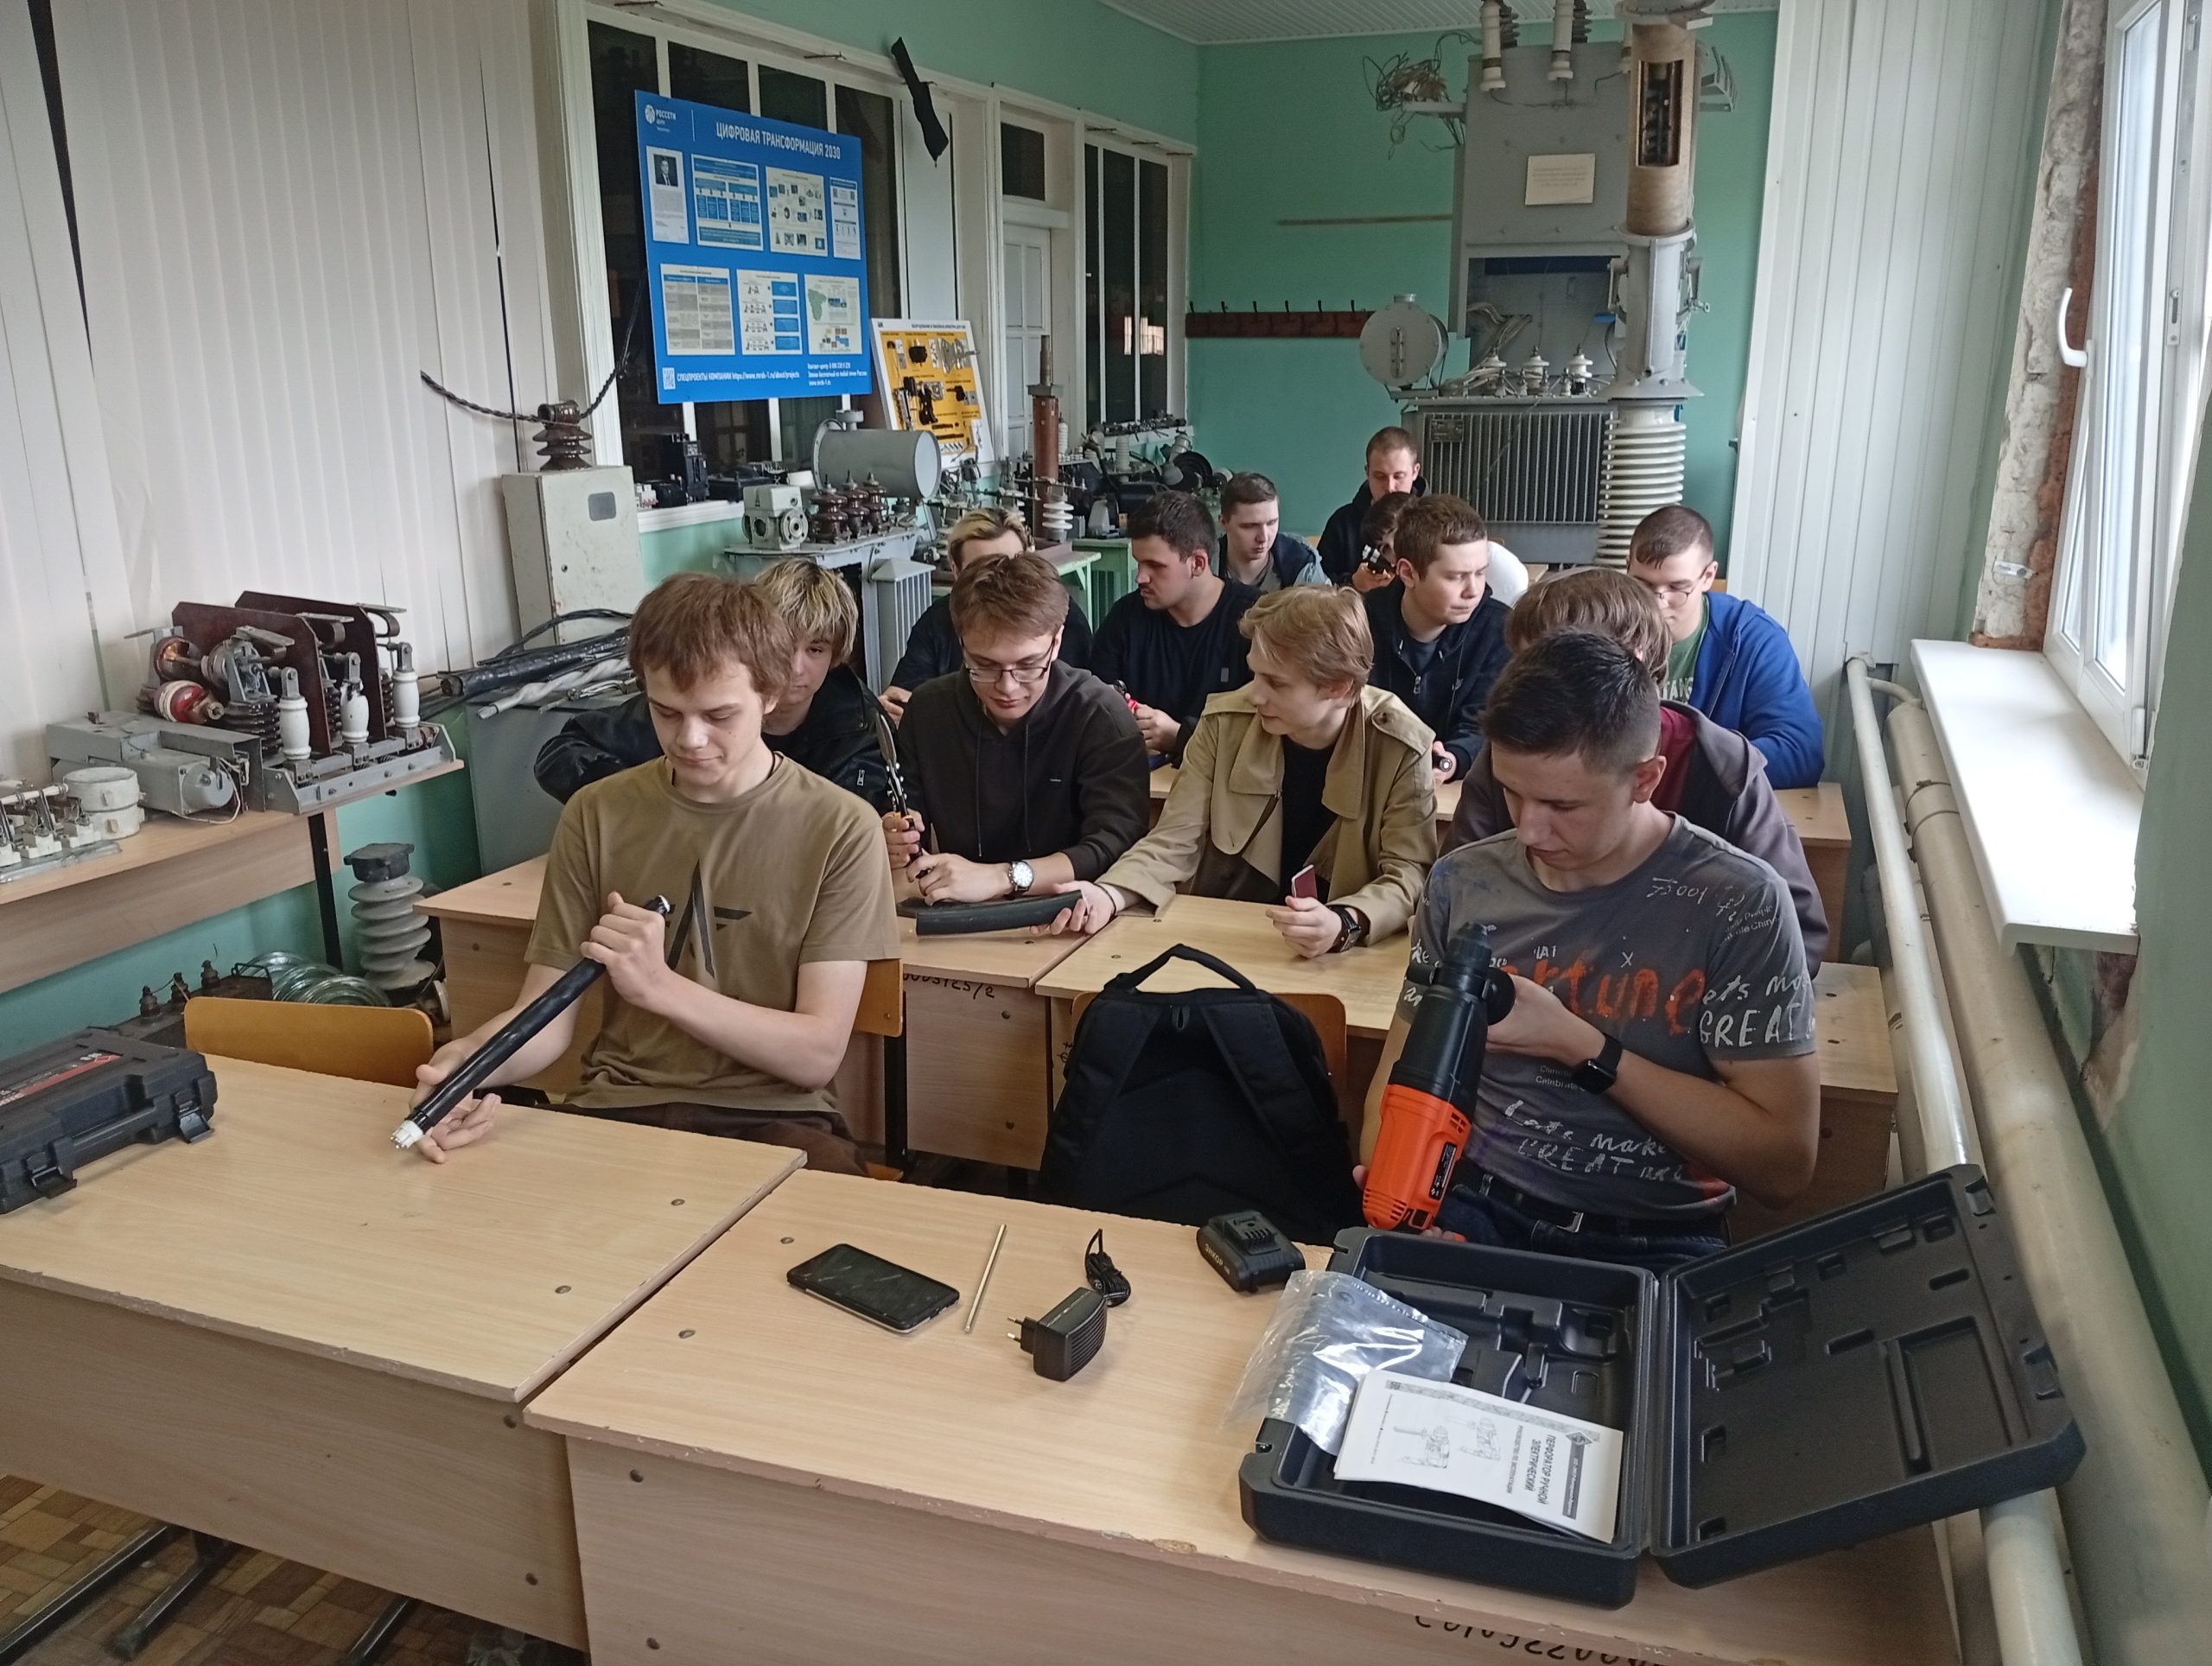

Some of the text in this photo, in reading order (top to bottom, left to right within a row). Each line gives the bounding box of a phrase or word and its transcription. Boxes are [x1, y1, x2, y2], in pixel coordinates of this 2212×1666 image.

[715, 122, 842, 160] ЦИФРОВАЯ ТРАНСФОРМАЦИЯ 2030
[1524, 1439, 1541, 1492] ЭЛЕКТРИЧЕСКИЙ
[1536, 1434, 1556, 1505] ПЕРФОРАТОР РУЧНОЙ
